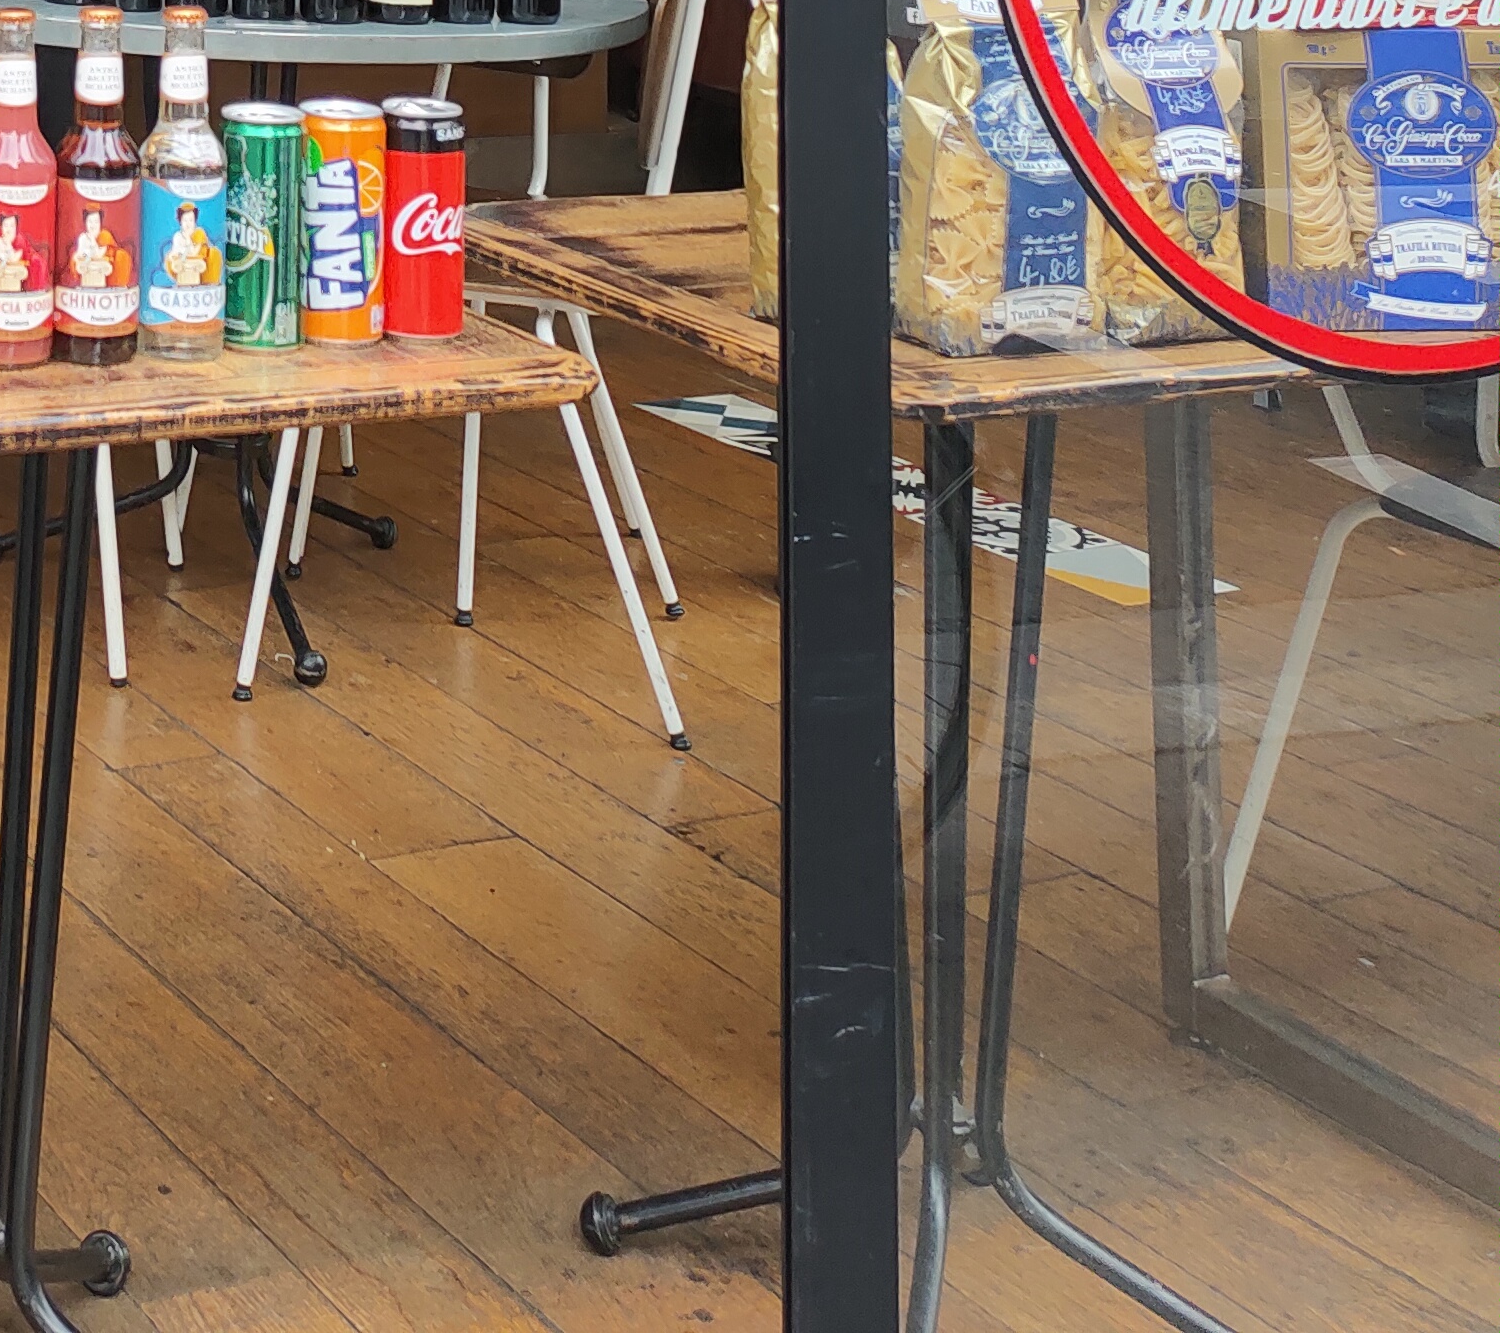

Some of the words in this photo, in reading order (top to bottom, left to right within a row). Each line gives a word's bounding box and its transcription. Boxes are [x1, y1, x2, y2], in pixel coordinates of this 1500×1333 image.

[302, 158, 366, 311] FANTA
[391, 192, 464, 256] Coca
[60, 291, 138, 310] CHINOTTO
